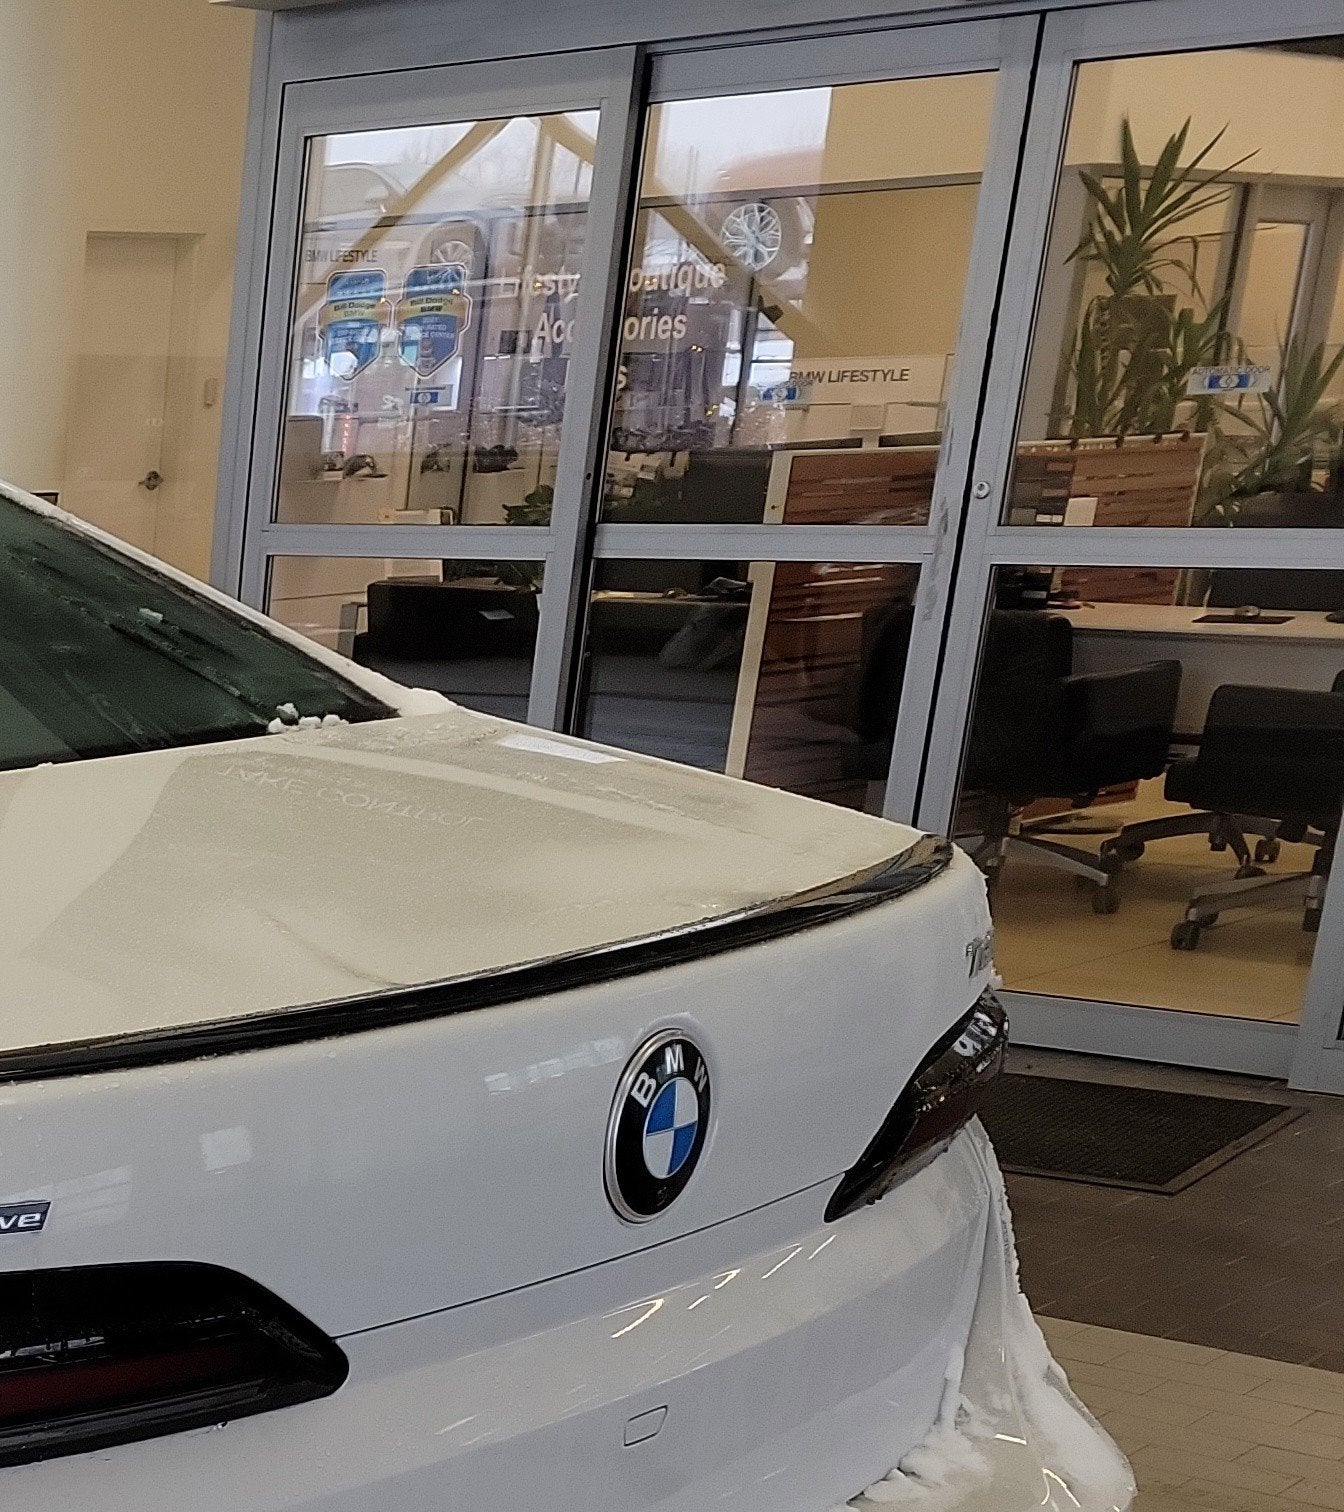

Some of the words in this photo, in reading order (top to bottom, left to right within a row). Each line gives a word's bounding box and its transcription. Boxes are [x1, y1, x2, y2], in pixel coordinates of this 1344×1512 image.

[629, 262, 727, 297] outique
[827, 369, 911, 384] LIFESTYLE
[631, 1043, 708, 1108] BMW
